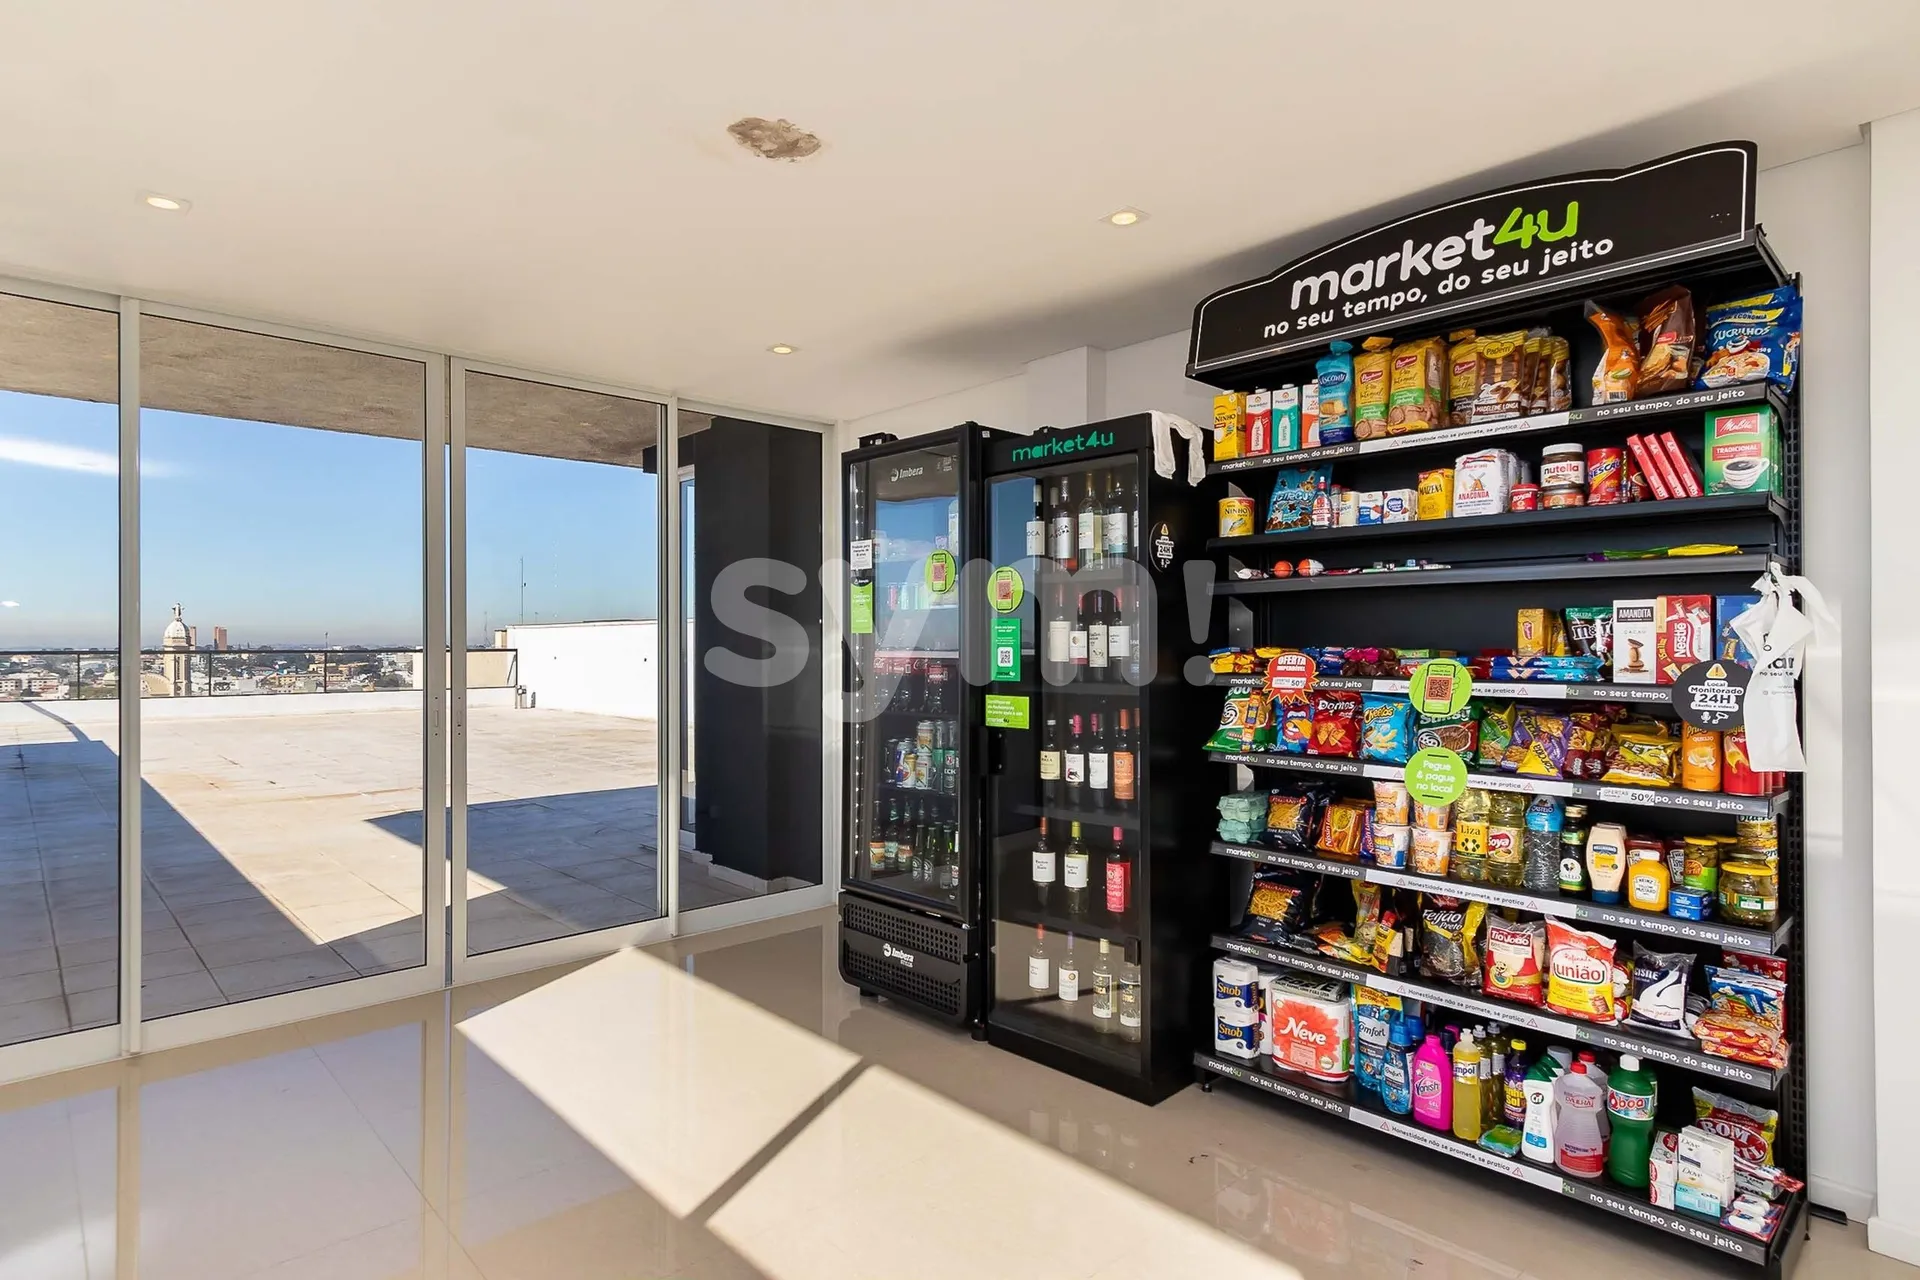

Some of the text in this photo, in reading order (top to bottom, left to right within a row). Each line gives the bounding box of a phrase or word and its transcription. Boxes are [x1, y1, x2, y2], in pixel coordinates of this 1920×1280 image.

[1290, 201, 1579, 310] market4u
[1263, 238, 1614, 338] no seu tempo, do seu jeito
[1713, 326, 1771, 346] SUCRILHOS
[1597, 388, 1745, 417] no seu tempo, do seu jeito
[1215, 414, 1235, 423] NINHO
[1012, 430, 1115, 462] market4u
[1286, 452, 1310, 461] tempo,
[1311, 450, 1320, 458] do
[1322, 448, 1335, 456] seu
[1335, 446, 1353, 455] jeito
[1716, 444, 1759, 455] TRADICIONAL
[1544, 463, 1579, 476] nutella
[1458, 491, 1489, 500] ANACONDA
[1225, 507, 1248, 515] NINHO
[1619, 609, 1651, 618] AMANDITA
[1674, 623, 1687, 657] Nestlé
[1278, 655, 1306, 665] OFERTA
[1631, 690, 1668, 700] tempo,
[1699, 694, 1731, 704] 24H
[1318, 700, 1355, 712] Doritos
[1364, 705, 1394, 723] Cheetos
[1225, 754, 1258, 763] market4u
[1290, 760, 1313, 769] tempo,
[1340, 763, 1357, 772] jeito
[1422, 760, 1452, 772] Pegue
[1416, 771, 1455, 784] & pague
[1416, 783, 1453, 793] no local
[1631, 793, 1654, 802] 50%
[1675, 796, 1743, 811] do seu jeito
[1460, 825, 1480, 836] Liza
[1226, 848, 1259, 859] market4u
[1291, 858, 1315, 869] tempo,
[1317, 862, 1326, 870] do
[1328, 865, 1340, 874] seu
[1341, 865, 1359, 876] jeito
[1422, 909, 1462, 923] Feijão
[1440, 922, 1463, 930] Preto
[1602, 913, 1751, 946] no seu tempo, do seu jeito
[1227, 943, 1259, 955] market4u
[1291, 958, 1315, 970] tempo,
[1317, 964, 1326, 972] do
[1328, 968, 1340, 977] seu
[1341, 969, 1359, 981] jeito
[1557, 964, 1601, 981] união
[1217, 983, 1242, 997] Snob
[1219, 1024, 1243, 1037] Snob
[1280, 1017, 1326, 1045] Neve
[1358, 1020, 1386, 1037] Comfort
[1604, 1036, 1752, 1081] no seu tempo, do seu jeito
[1209, 1060, 1342, 1113] market4u no seu tempo, do seu jeito
[1415, 1080, 1440, 1096] Vanish
[1609, 1091, 1644, 1110] Qboa
[1700, 1121, 1750, 1144] BOM
[1681, 1137, 1700, 1149] Dove
[1682, 1166, 1702, 1178] Dove
[1590, 1193, 1743, 1252] no seu tempo, do seu jeito
